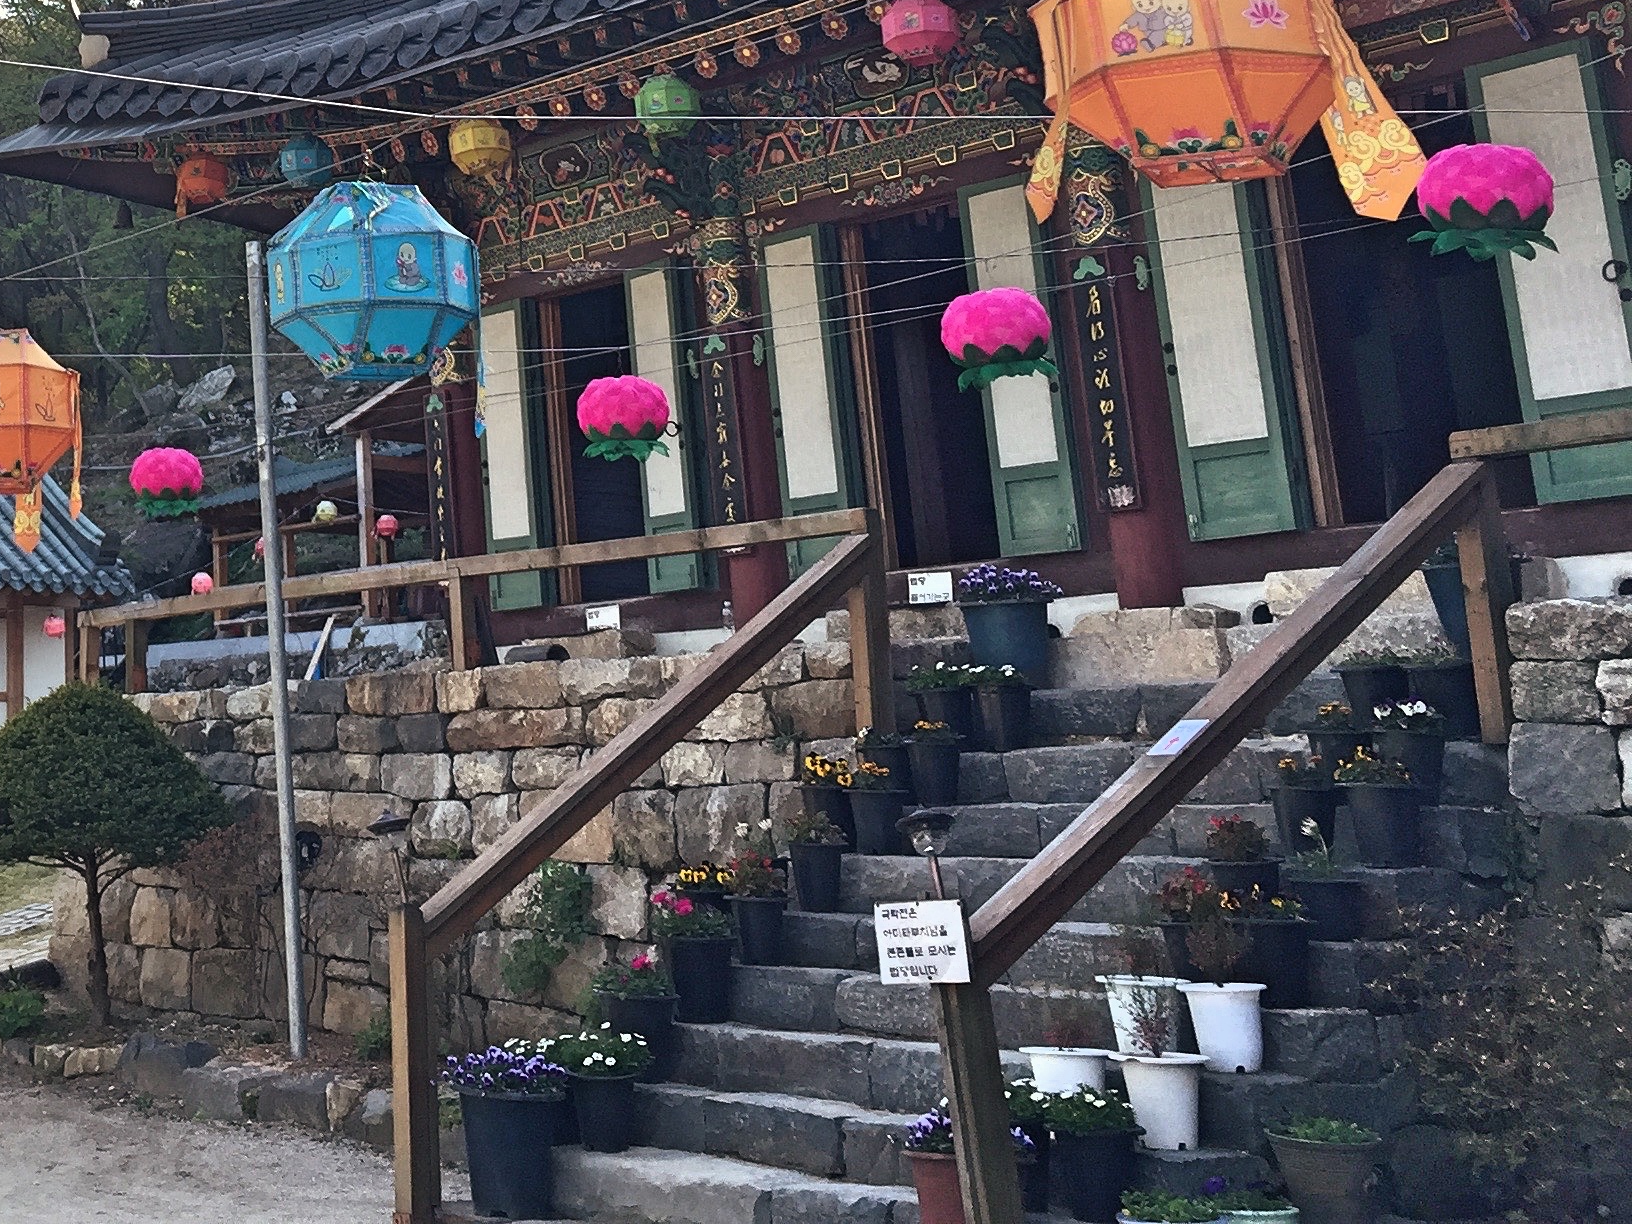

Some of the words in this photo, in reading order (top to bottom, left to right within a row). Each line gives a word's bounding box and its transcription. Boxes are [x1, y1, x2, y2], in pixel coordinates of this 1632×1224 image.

[881, 907, 918, 920] 극락전은
[928, 944, 956, 956] 모시는
[889, 964, 938, 978] 법당입니다
